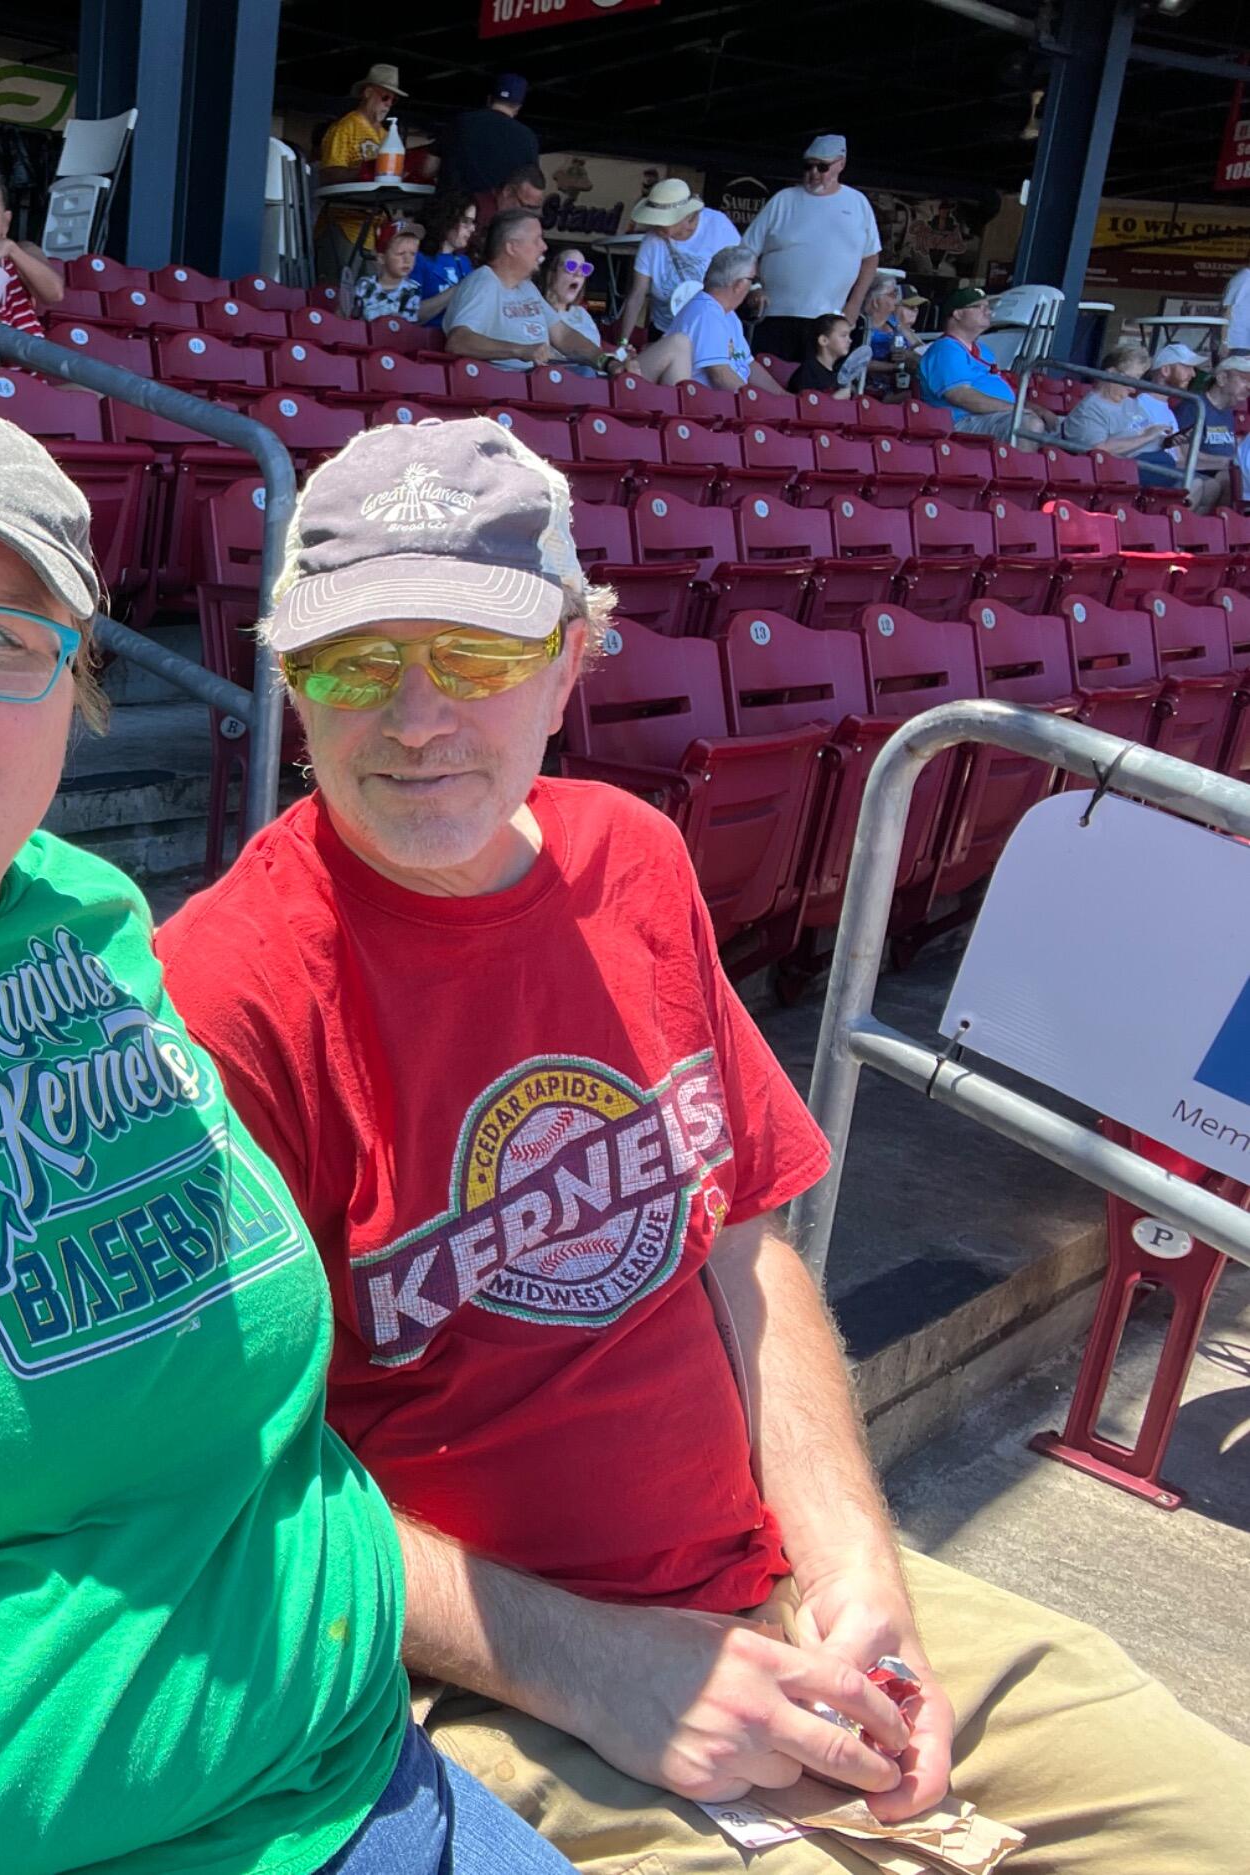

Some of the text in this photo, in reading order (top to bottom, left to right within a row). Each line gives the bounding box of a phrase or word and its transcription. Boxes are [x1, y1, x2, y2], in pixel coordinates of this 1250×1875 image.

[1109, 216, 1137, 233] 10
[1144, 219, 1187, 235] WIN
[360, 481, 478, 517] Great Harvest
[754, 627, 767, 641] 13
[476, 1076, 601, 1169] CEDAR RAPIDS
[367, 1074, 725, 1347] KERNELS
[1150, 1227, 1174, 1247] P
[12, 1165, 286, 1345] BASEBALL
[489, 1208, 670, 1308] MIDWEST LEAGUE
